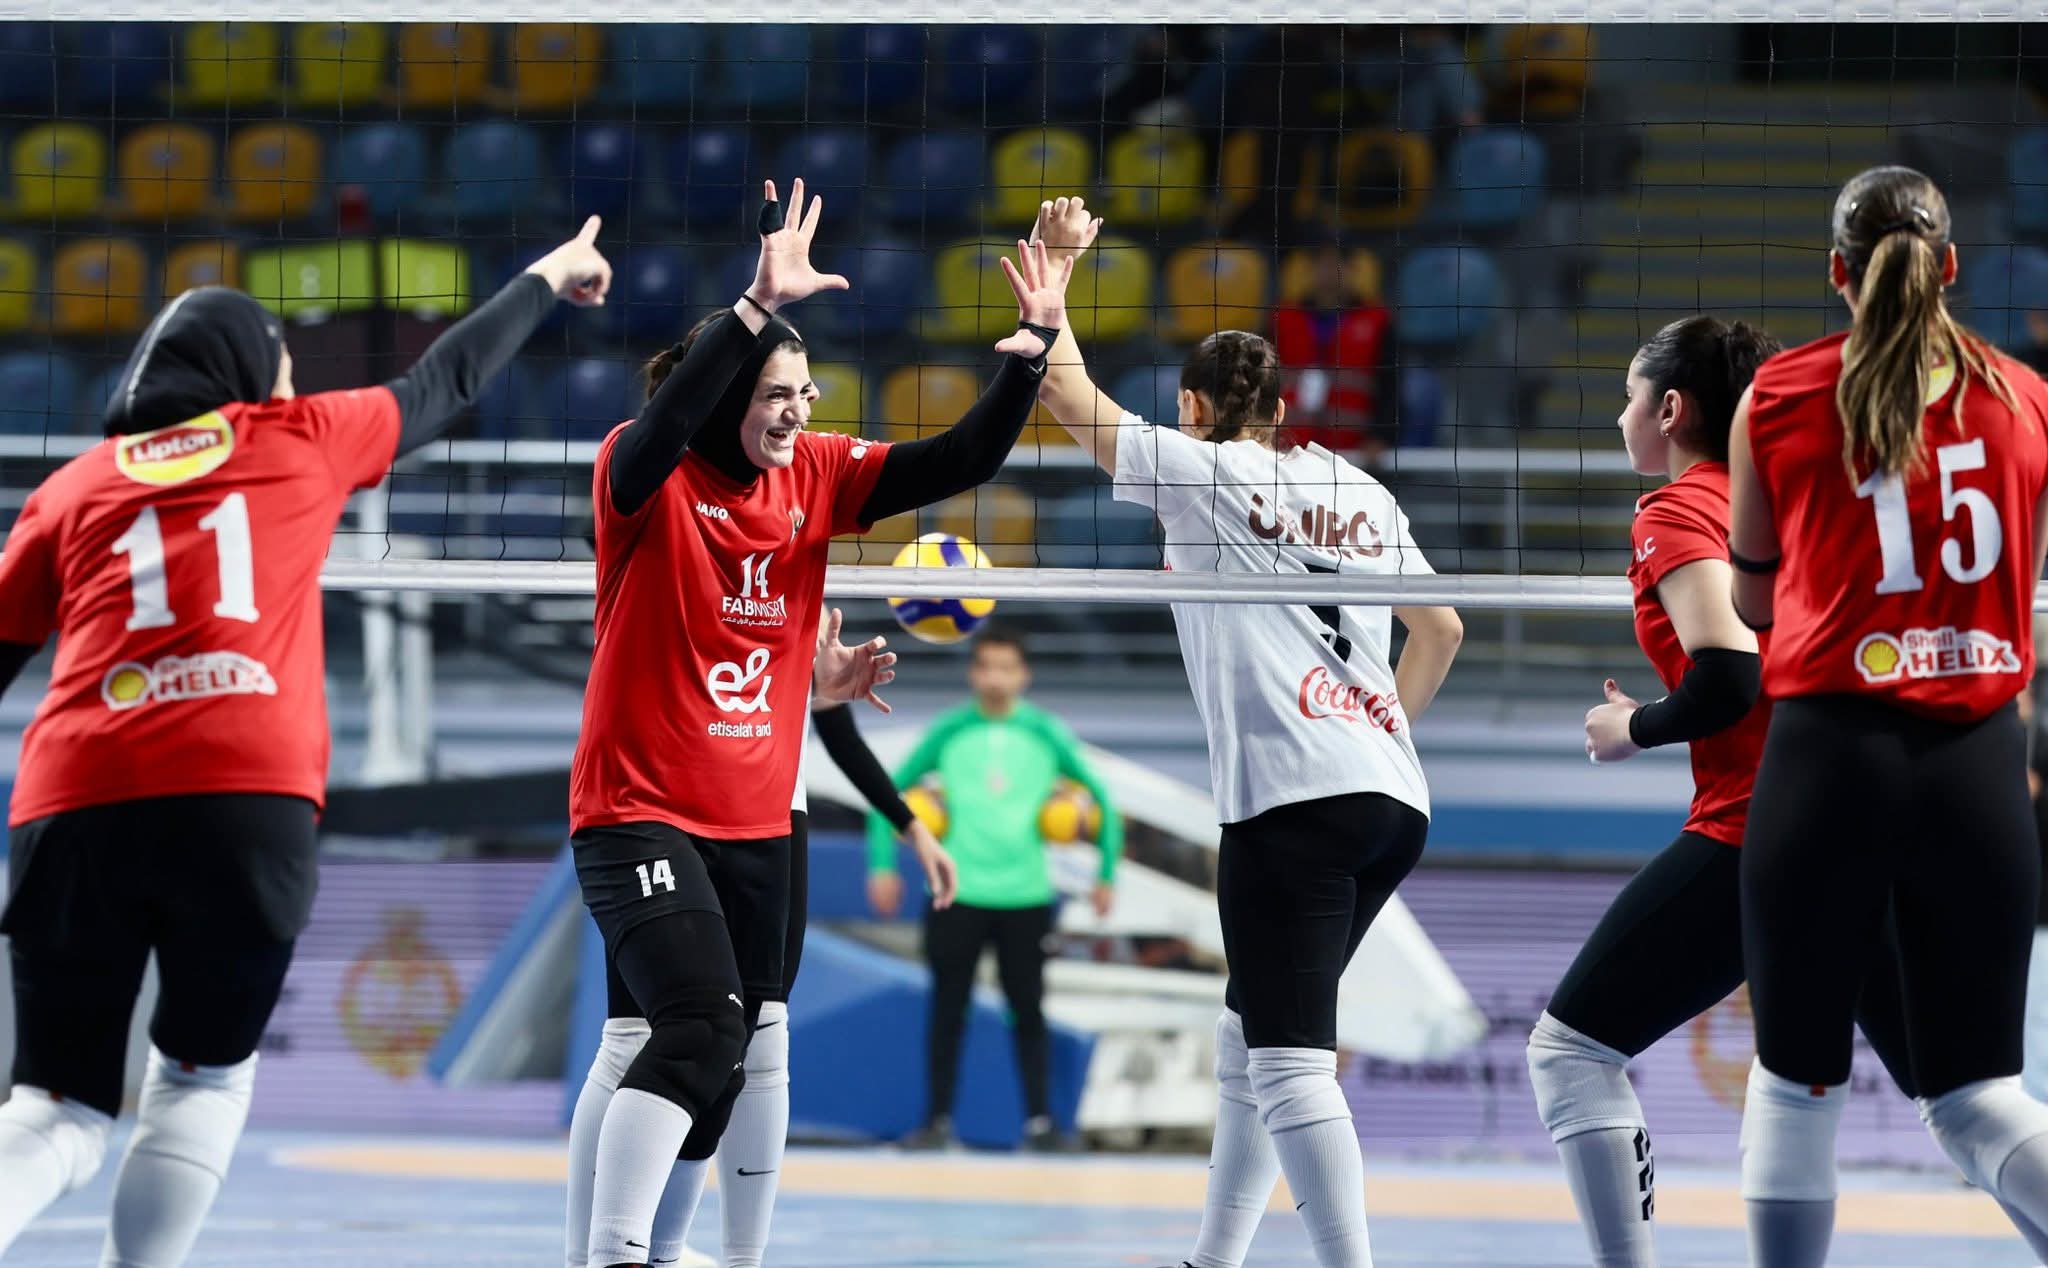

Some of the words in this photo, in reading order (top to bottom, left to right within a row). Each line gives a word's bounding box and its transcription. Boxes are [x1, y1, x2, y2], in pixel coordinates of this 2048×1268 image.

[132, 431, 218, 463] Lipton
[695, 500, 729, 520] JAKO
[1855, 437, 2001, 596] 15
[111, 491, 261, 632] 11
[739, 552, 775, 599] 14
[1906, 630, 1954, 649] Shell
[1909, 646, 2011, 673] HELIX
[158, 666, 269, 696] HELI
[1298, 665, 1406, 736] Coca-Co
[707, 720, 754, 738] etisalat
[755, 719, 772, 737] and
[635, 859, 677, 898] 14
